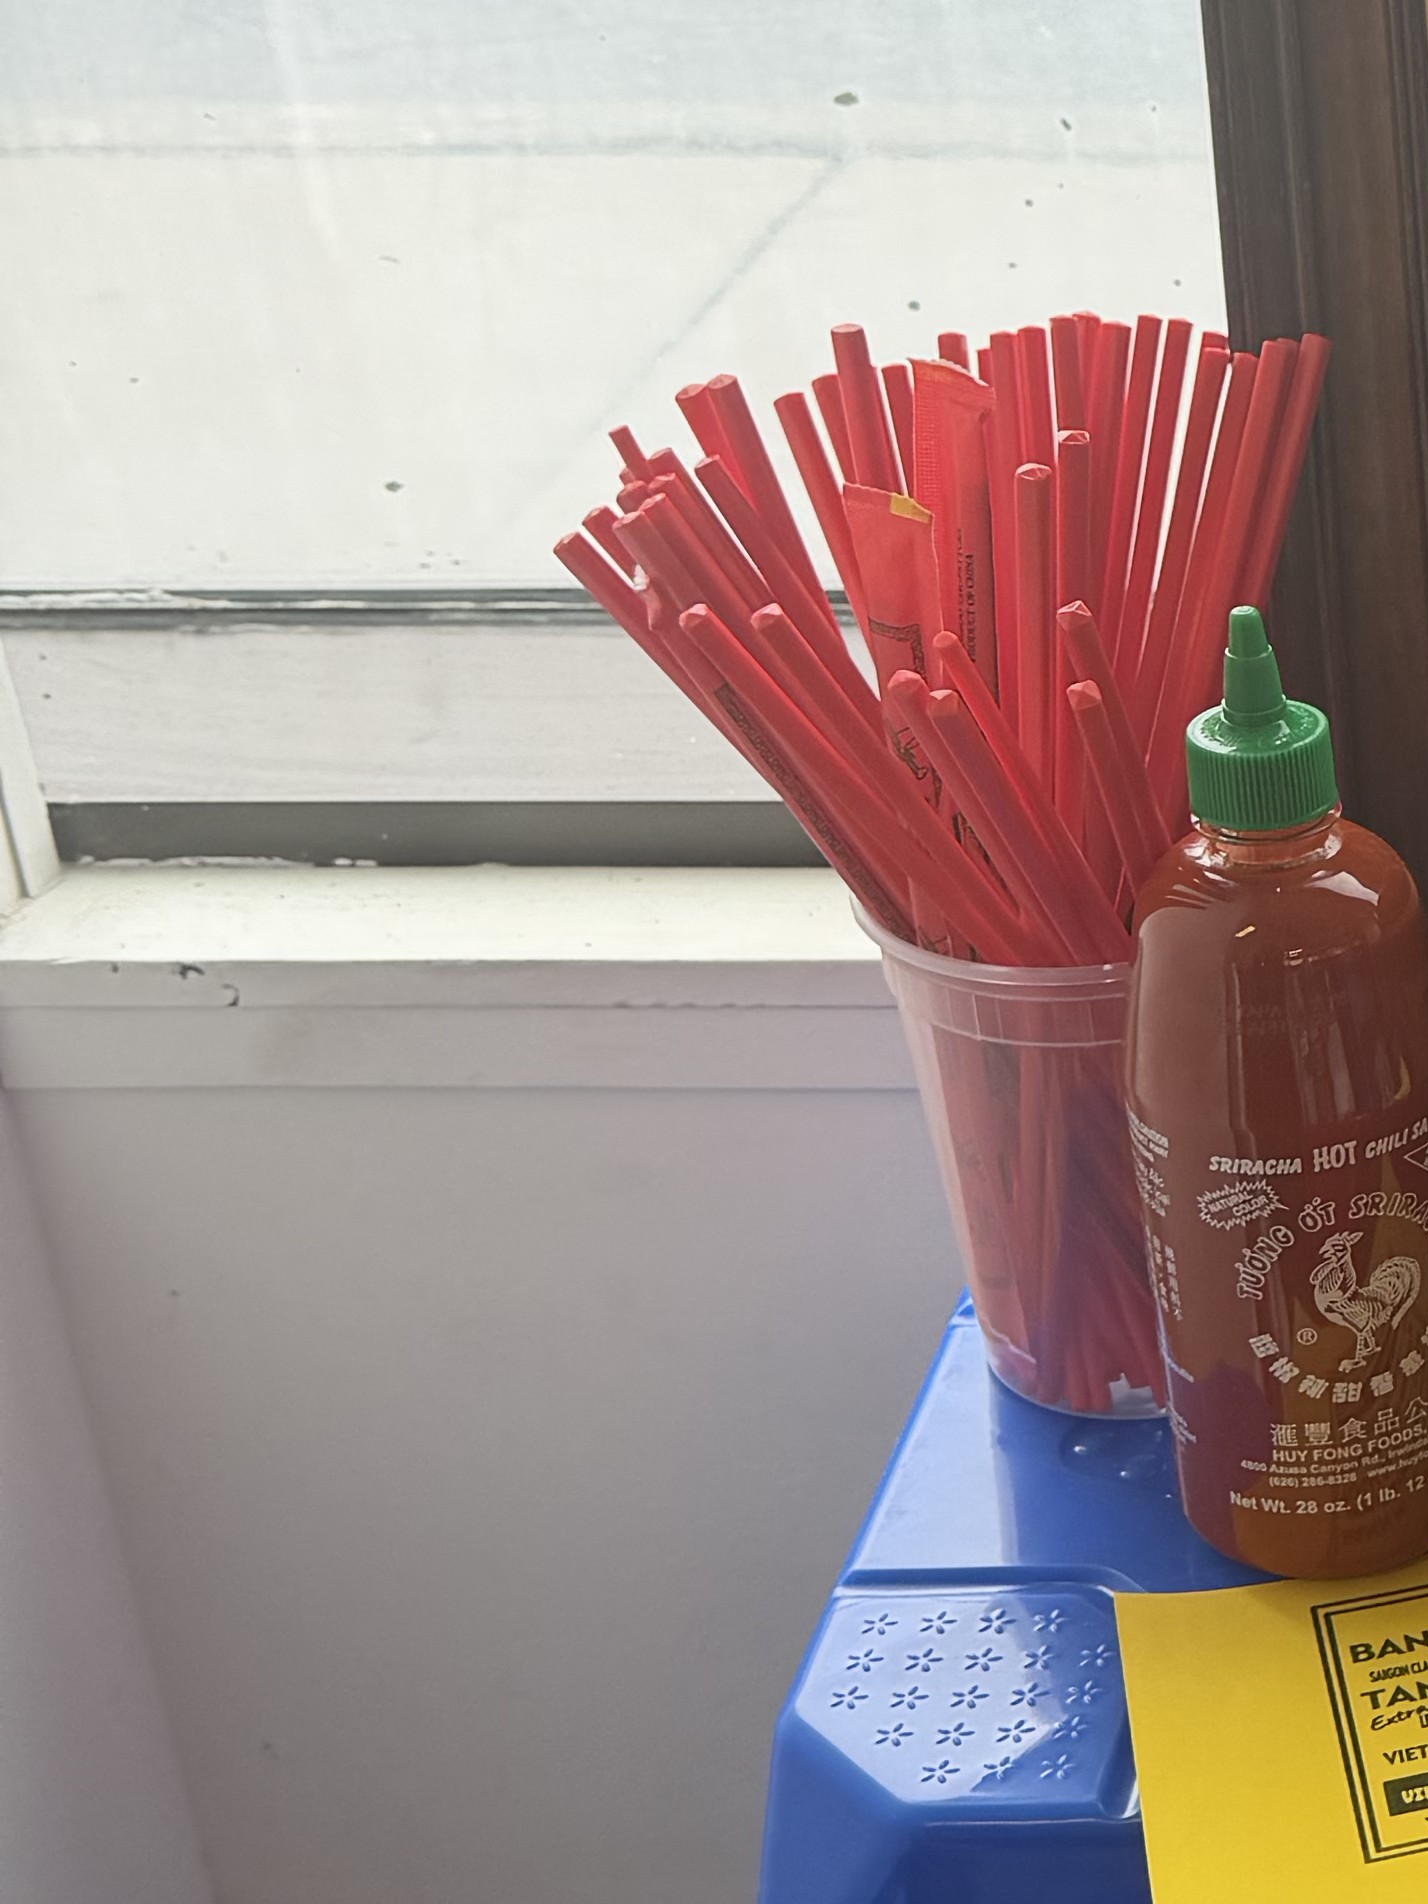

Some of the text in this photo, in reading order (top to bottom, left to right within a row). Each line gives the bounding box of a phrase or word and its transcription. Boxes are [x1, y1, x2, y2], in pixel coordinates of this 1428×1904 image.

[1208, 1155, 1302, 1176] SRIRACHA
[1312, 1141, 1358, 1173] HOT
[1364, 1132, 1408, 1159] CHILI
[1207, 1192, 1254, 1213] NATURAL
[1232, 1195, 1269, 1217] COLOR
[1272, 1449, 1308, 1463] HUY
[1313, 1444, 1363, 1462] FONG
[1310, 1461, 1359, 1474] Canyon
[1229, 1490, 1257, 1512] Net
[1260, 1497, 1291, 1514] Wt.
[1295, 1499, 1319, 1515] 28
[1323, 1498, 1351, 1514] oz.
[1378, 1487, 1401, 1503] lb.
[1405, 1475, 1426, 1493] 12
